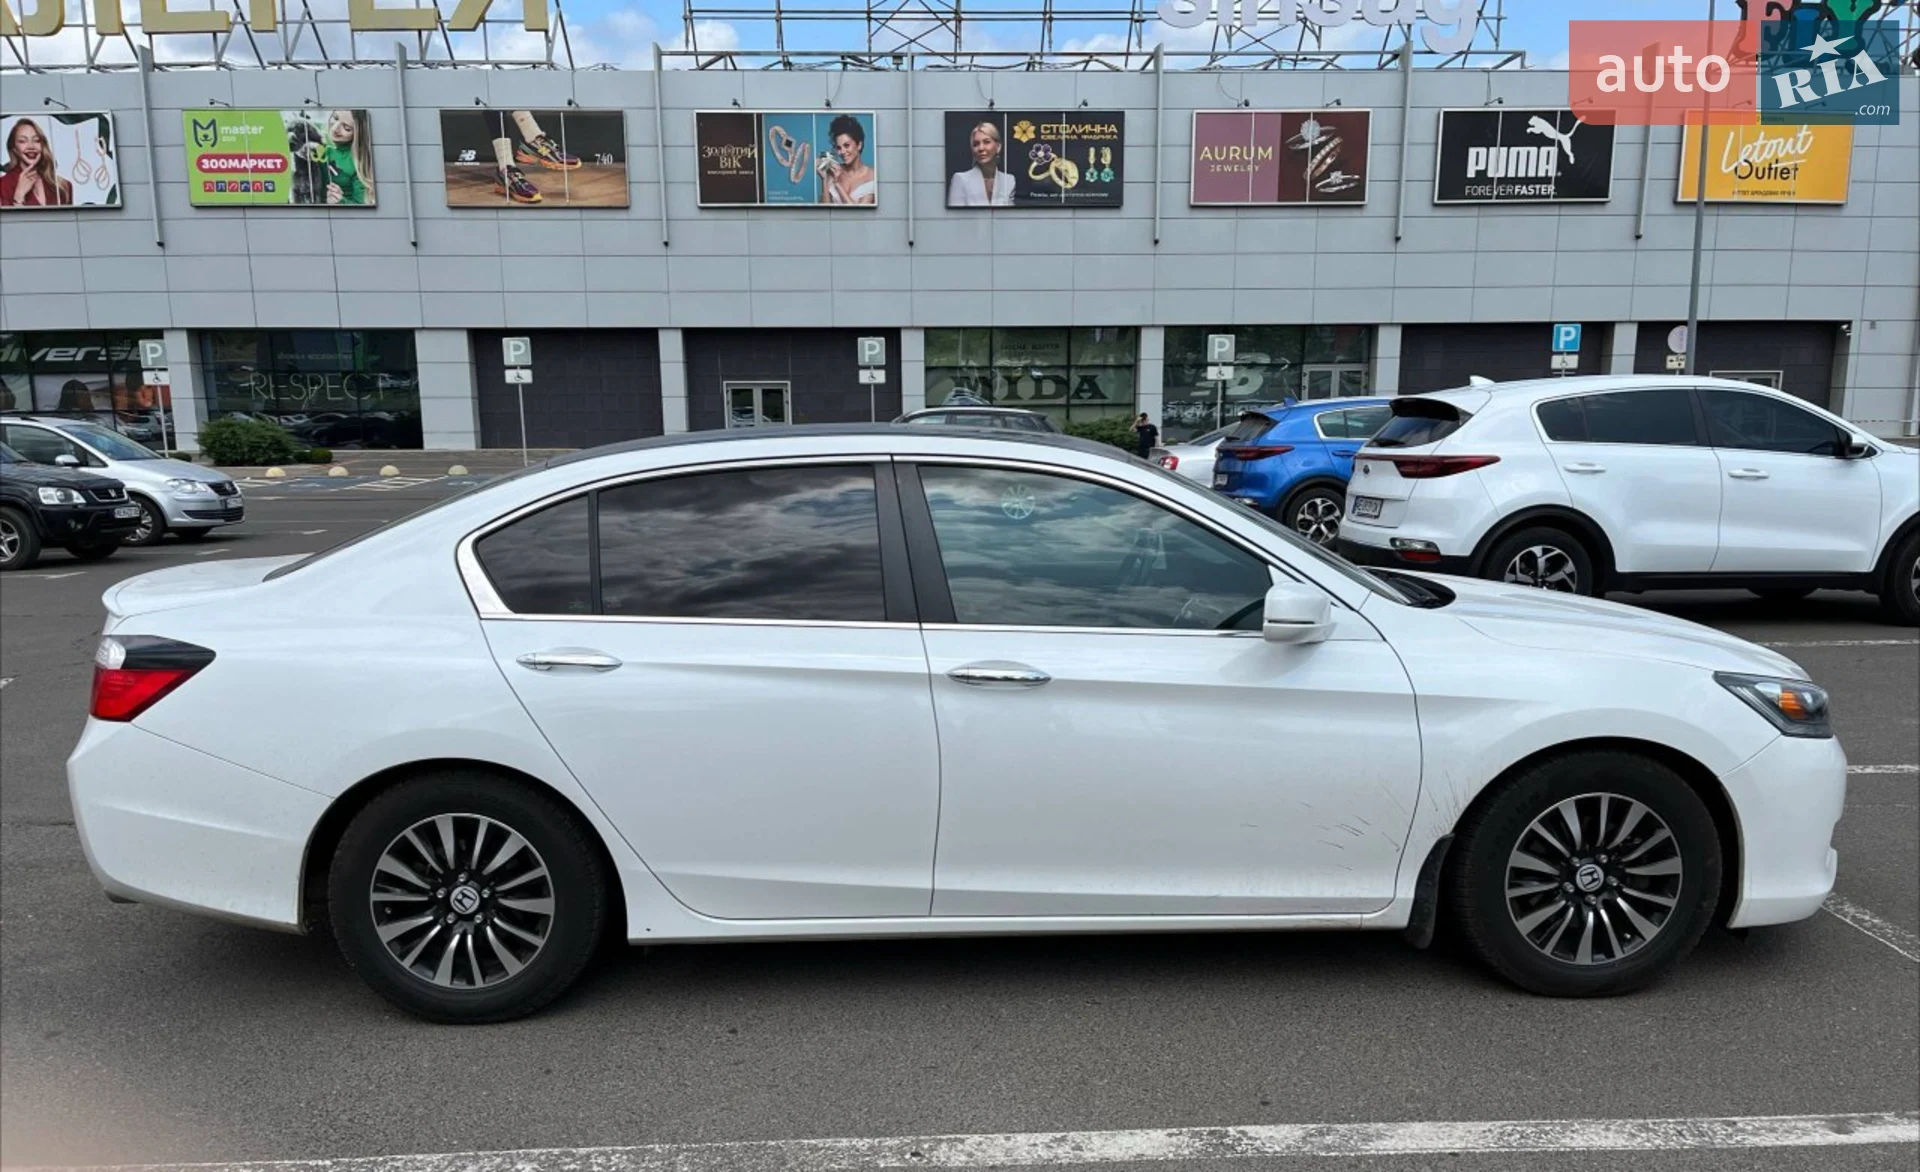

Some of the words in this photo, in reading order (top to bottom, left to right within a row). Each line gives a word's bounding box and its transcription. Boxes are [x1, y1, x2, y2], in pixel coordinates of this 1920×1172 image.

[221, 124, 264, 134] master
[1040, 124, 1118, 134] СТОЛИЧНА
[202, 158, 283, 169] ЗООМАРКЕТ
[594, 153, 613, 165] 740
[1200, 146, 1273, 160] AURUM
[1466, 146, 1559, 178] PUMA
[1209, 164, 1260, 172] JEWELRY
[1734, 158, 1799, 181] Outlet
[1214, 336, 1231, 358] P
[1559, 327, 1576, 349] P
[145, 343, 161, 365] P
[510, 340, 526, 362] P
[864, 340, 880, 362] P
[250, 372, 390, 400] RESPECT
